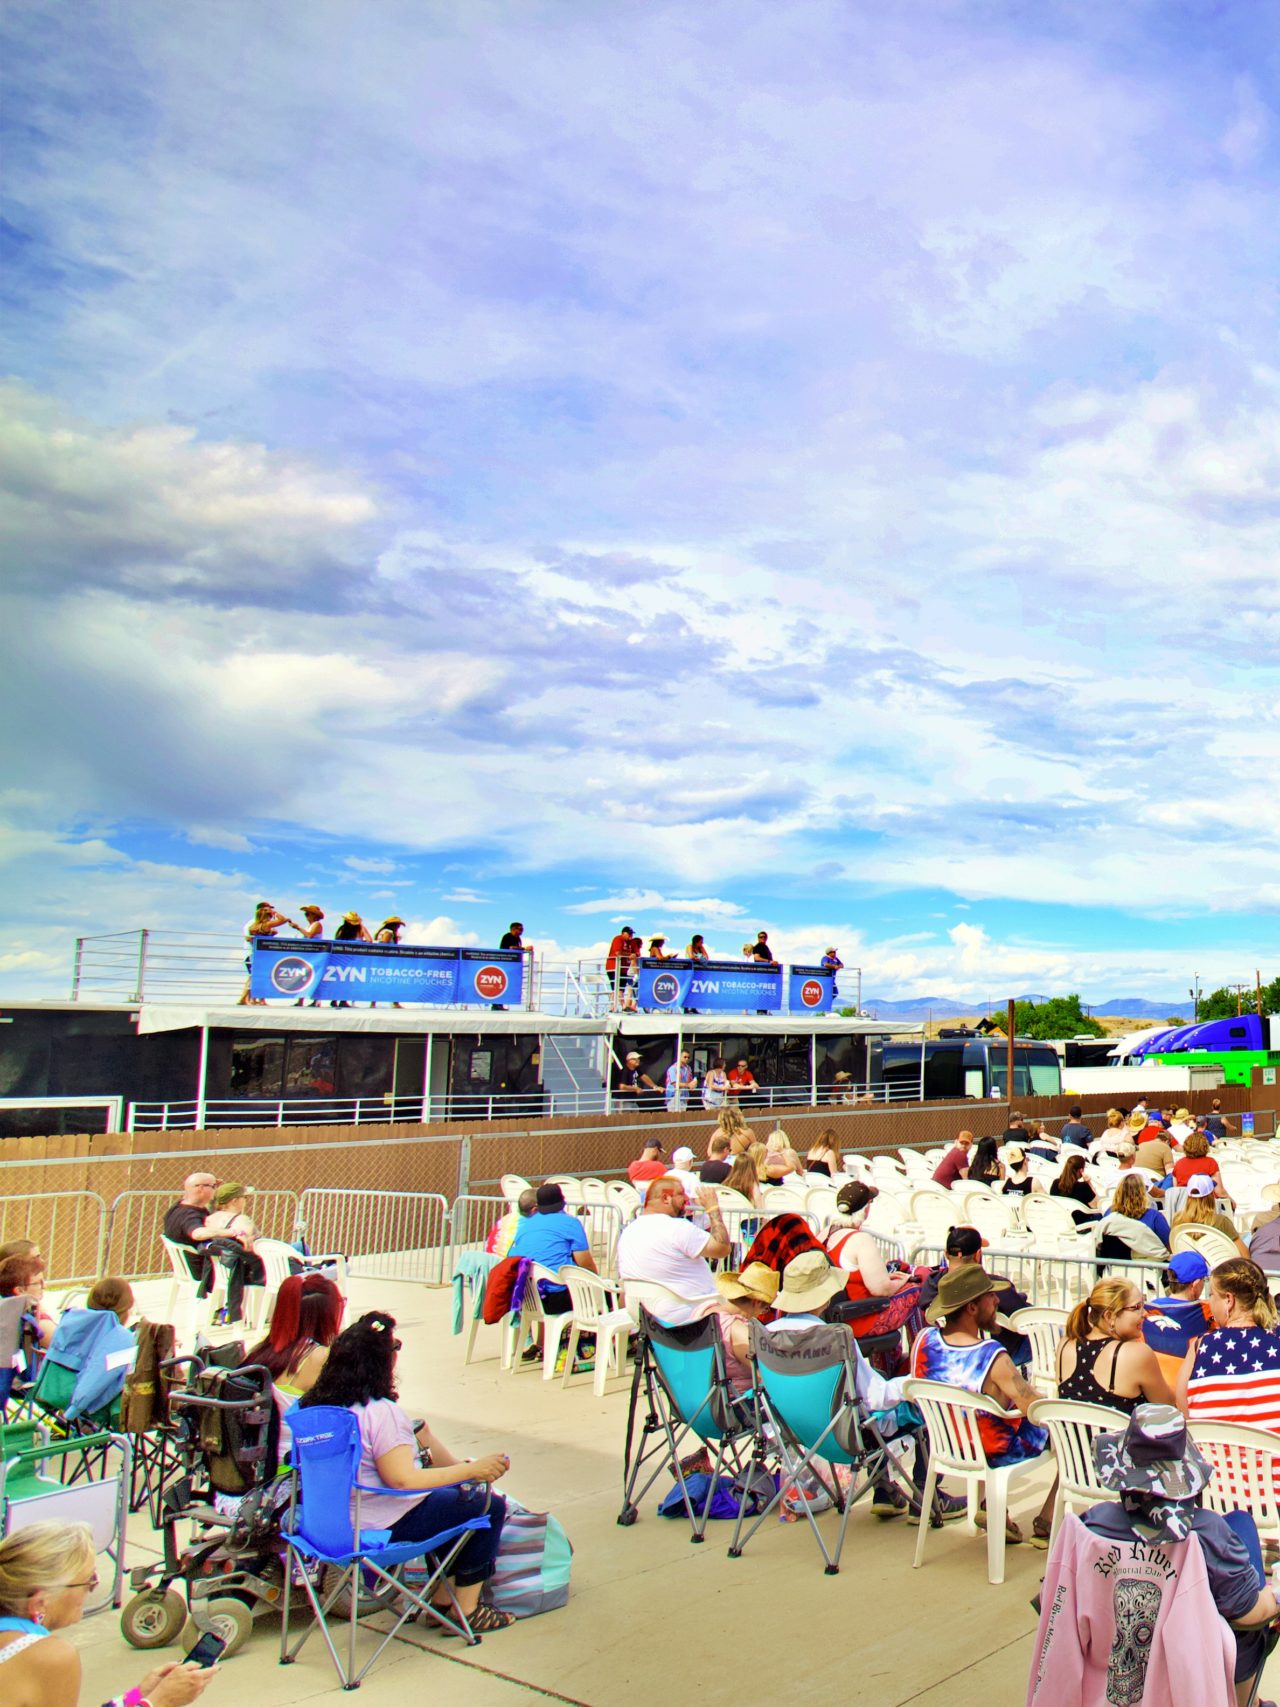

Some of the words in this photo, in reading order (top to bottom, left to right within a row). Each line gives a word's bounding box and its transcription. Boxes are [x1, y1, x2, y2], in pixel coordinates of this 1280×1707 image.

[279, 967, 306, 977] ZYN
[322, 966, 366, 982] ZYN
[370, 967, 453, 979] TOBACCO-FREE
[370, 977, 411, 985] NICOTINE
[413, 978, 453, 986] POUCHES
[480, 974, 502, 984] ZYN
[657, 982, 675, 991] ZYN
[691, 980, 719, 994] ZYN
[721, 981, 777, 990] TOBACCO-FREE
[805, 987, 820, 995] ZYN
[1093, 1545, 1121, 1578] Red
[1129, 1541, 1177, 1580] River
[1145, 1566, 1161, 1577] Day
